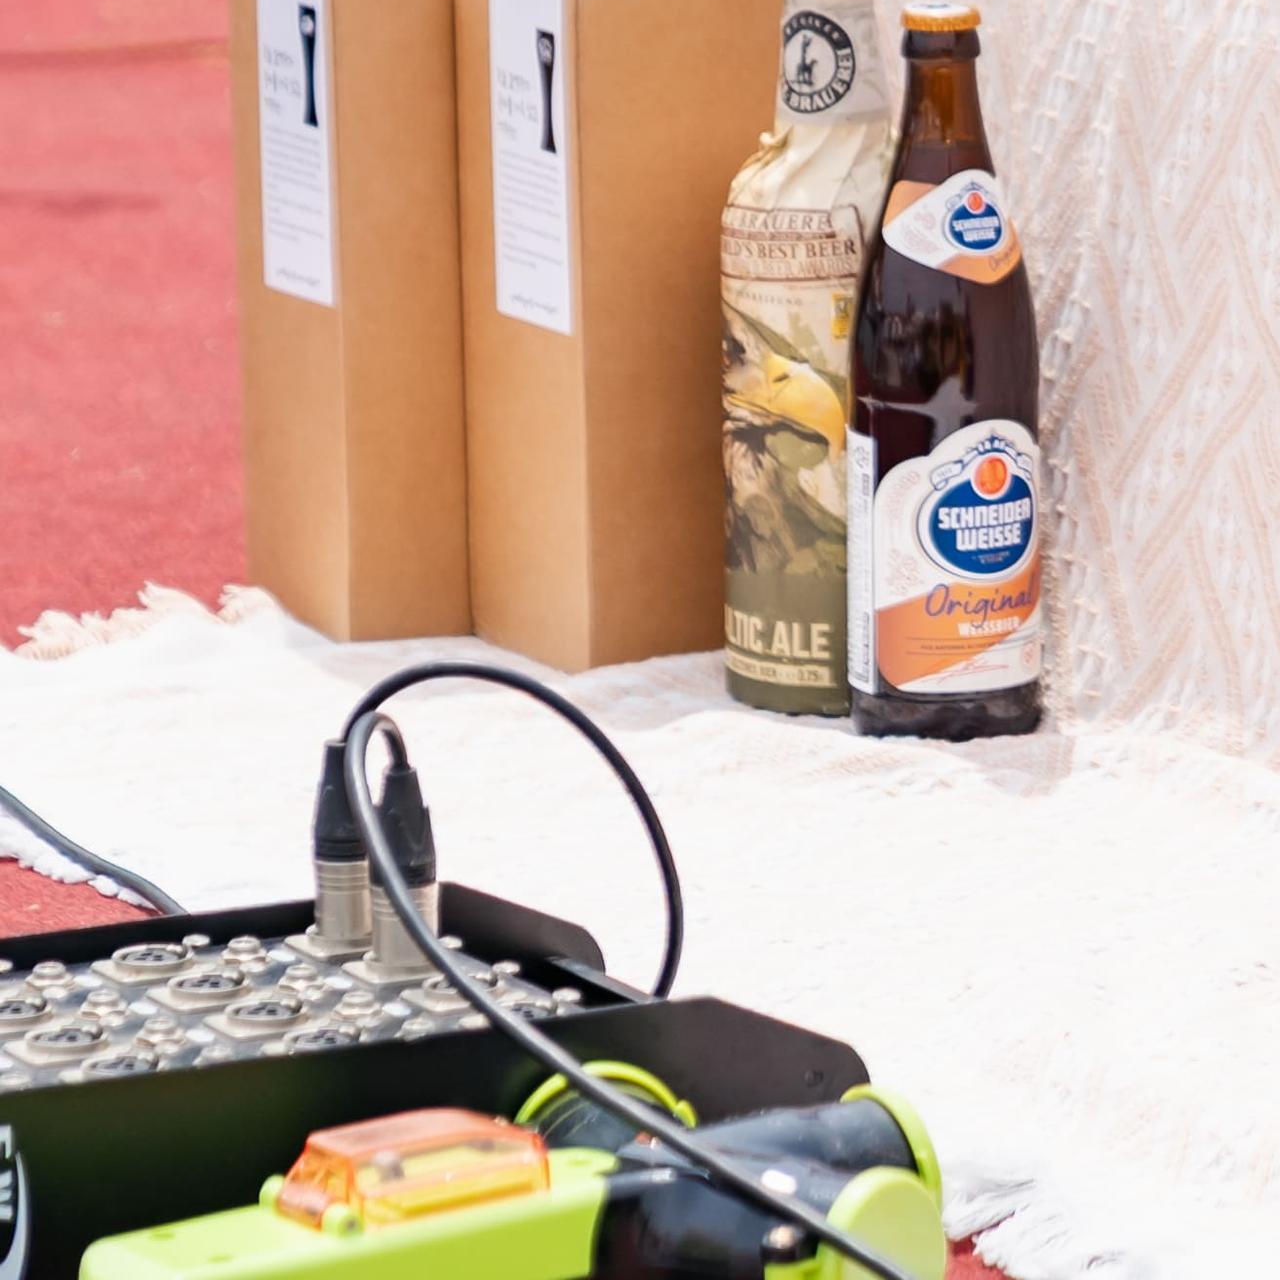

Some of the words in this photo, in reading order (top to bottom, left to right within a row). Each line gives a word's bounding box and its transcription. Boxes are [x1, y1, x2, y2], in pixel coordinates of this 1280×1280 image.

[756, 241, 799, 260] BEST
[804, 239, 858, 260] BEER
[937, 497, 1032, 530] SCHNEIDER
[955, 523, 1022, 552] WEISSE
[924, 570, 1036, 630] Original
[770, 619, 831, 659] ALE
